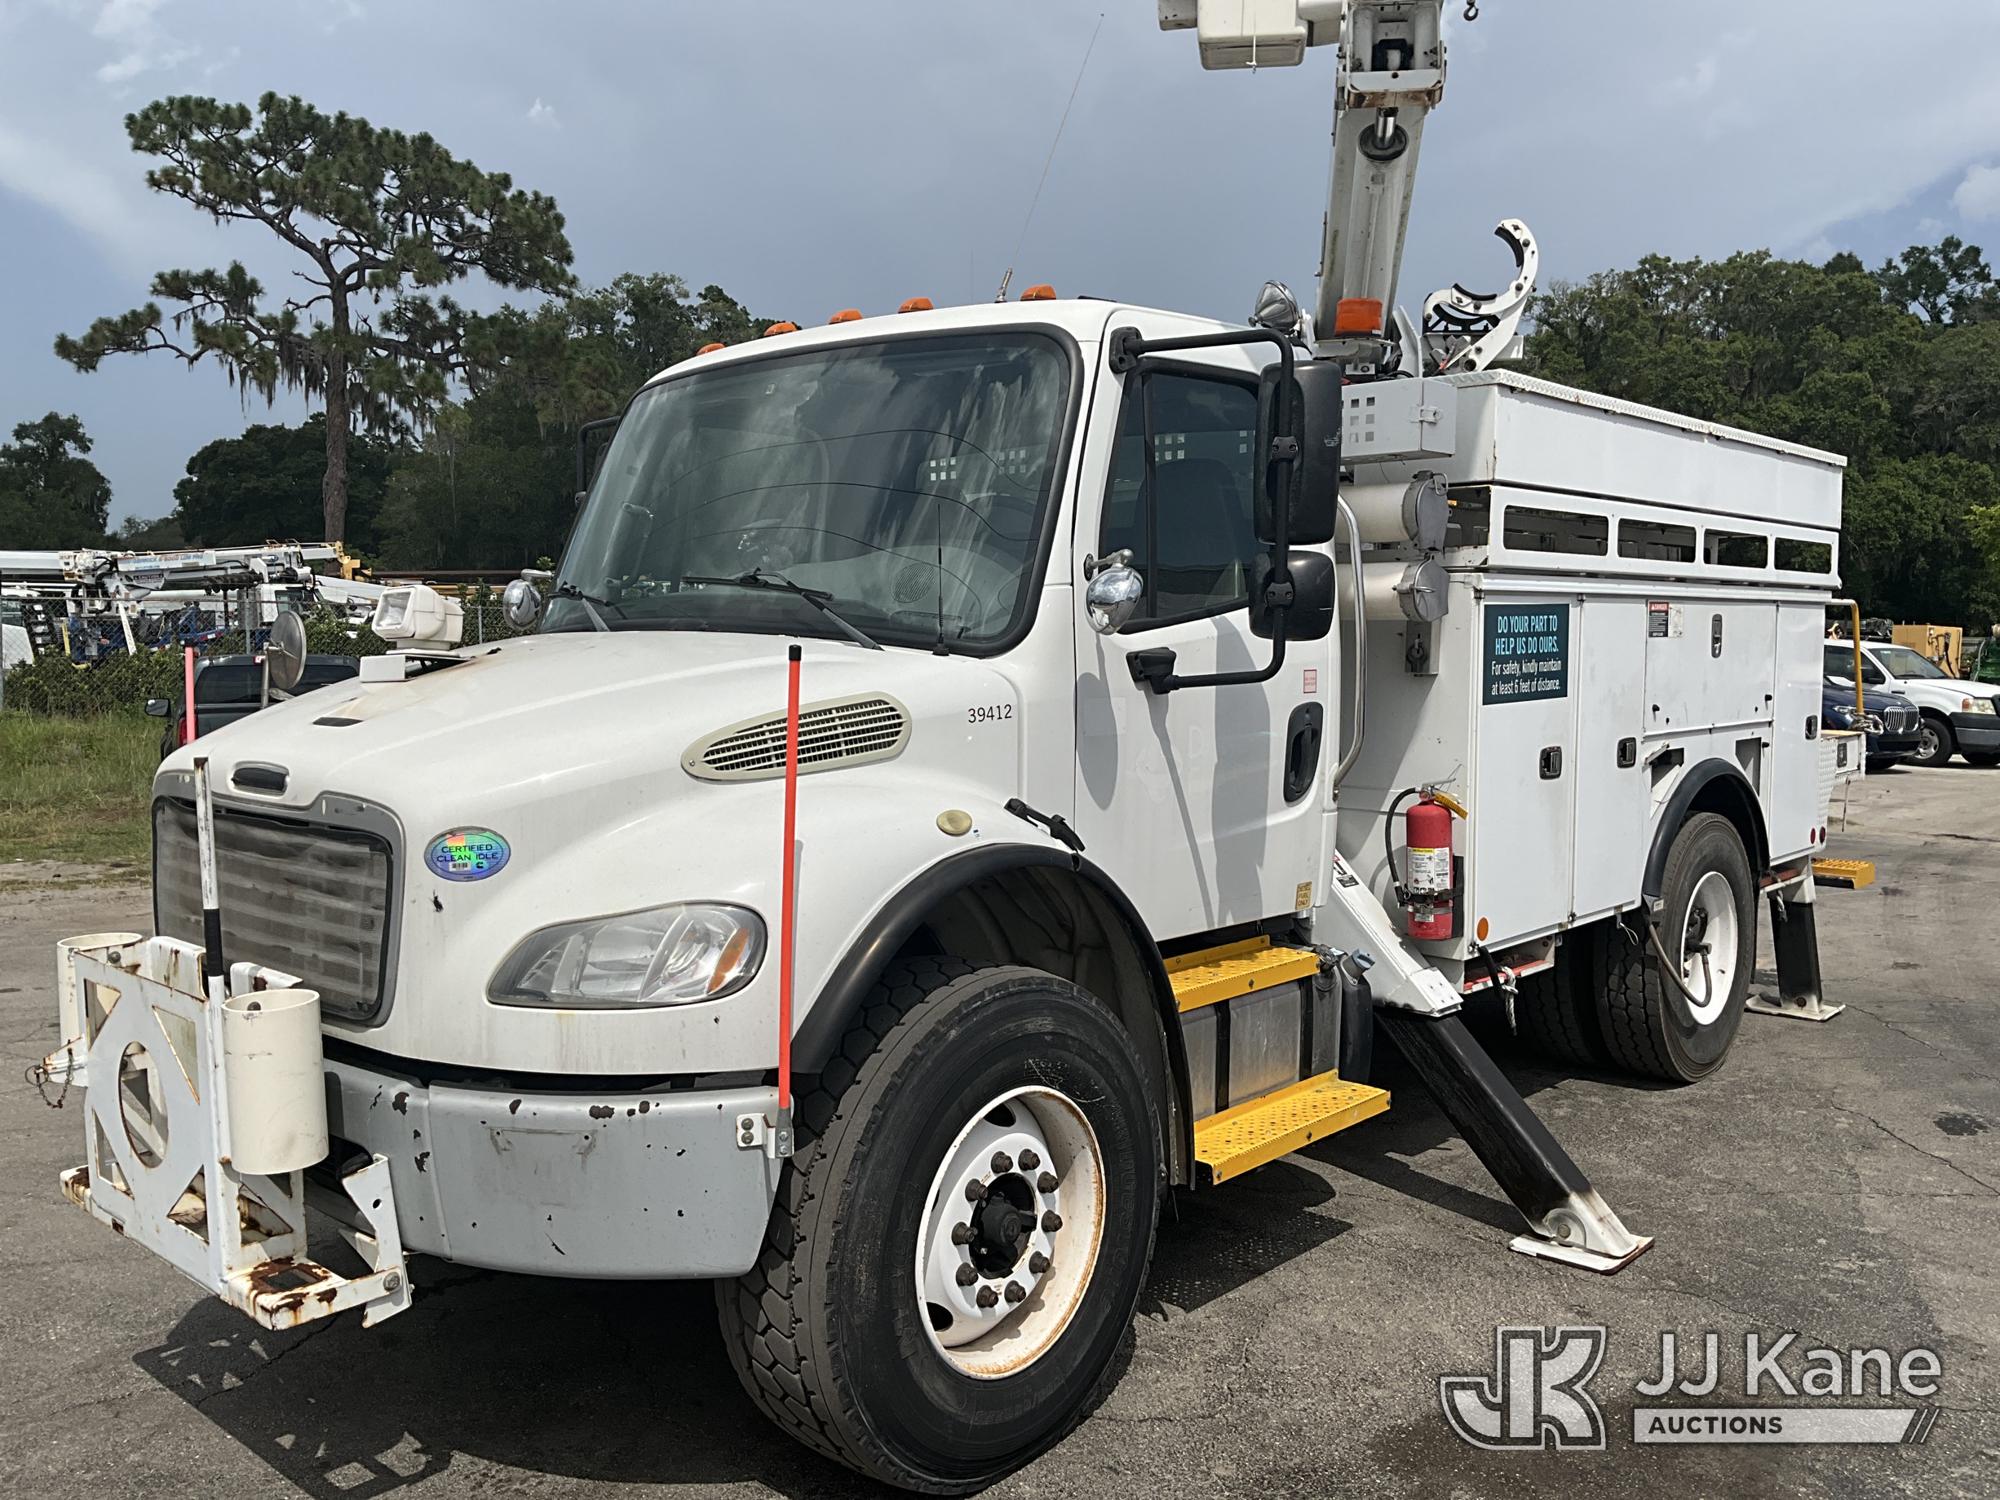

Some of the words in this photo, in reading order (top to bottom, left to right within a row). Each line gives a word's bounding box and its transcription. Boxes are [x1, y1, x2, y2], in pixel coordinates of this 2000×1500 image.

[1497, 615, 1508, 633] DO
[1509, 615, 1529, 633] YOUR
[1530, 615, 1548, 633] PART
[1549, 614, 1558, 632] TO
[1495, 637, 1515, 656] HELP
[1516, 636, 1526, 655] US
[1527, 636, 1538, 654] DO
[1539, 635, 1559, 653] OURS.
[1491, 660, 1501, 676] For
[1502, 660, 1521, 677] safety,
[1522, 658, 1538, 675] kindly
[1538, 657, 1562, 672] maintain
[1491, 683, 1498, 696] at
[1499, 680, 1514, 695] least
[1514, 679, 1519, 694] 6
[1519, 678, 1530, 693] feet
[1530, 677, 1537, 692] of
[1537, 677, 1560, 691] distance.
[968, 703, 1012, 723] 39412
[436, 854, 471, 863] CLEAN
[475, 852, 498, 861] IDLE
[441, 843, 493, 853] CERTIFIED
